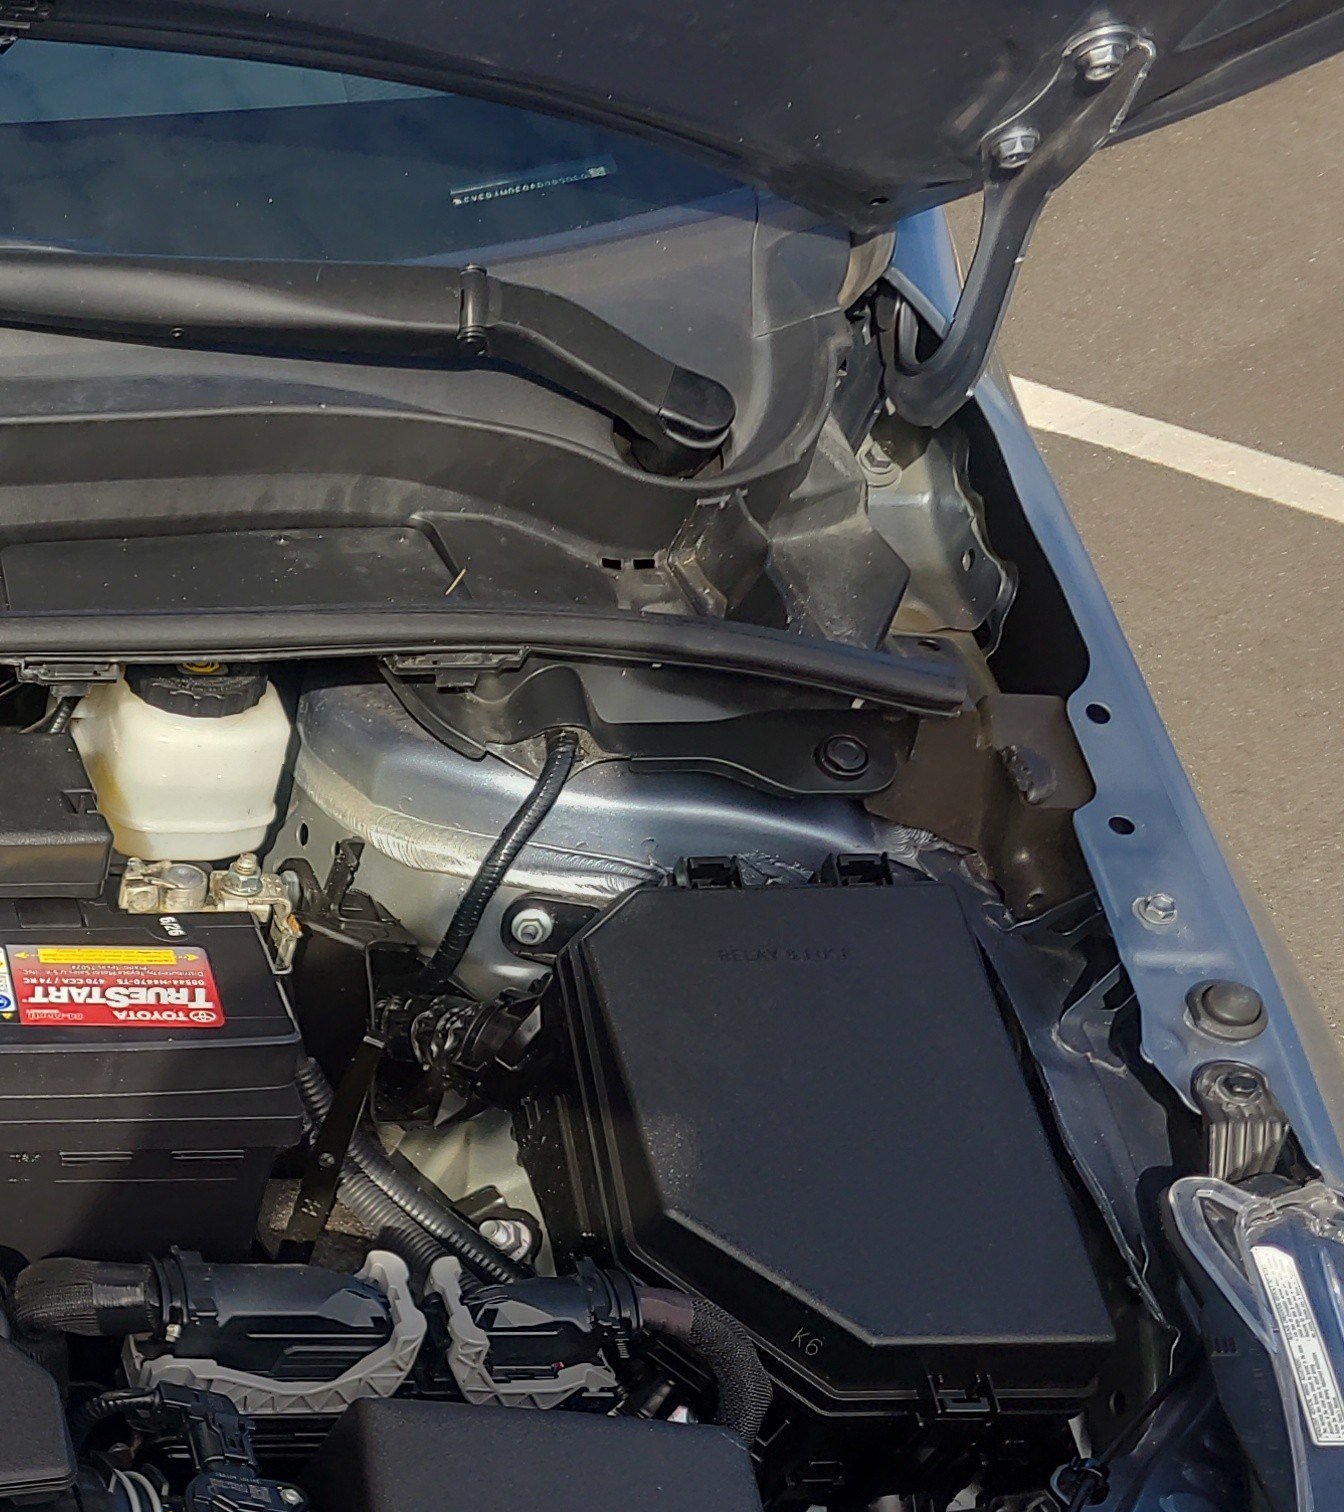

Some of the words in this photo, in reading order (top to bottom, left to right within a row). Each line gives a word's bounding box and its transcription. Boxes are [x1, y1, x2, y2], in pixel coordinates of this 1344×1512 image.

[158, 916, 188, 937] 6/26
[62, 977, 84, 986] CCA
[112, 1009, 190, 1021] TOYOTA
[790, 1326, 824, 1356] K6
